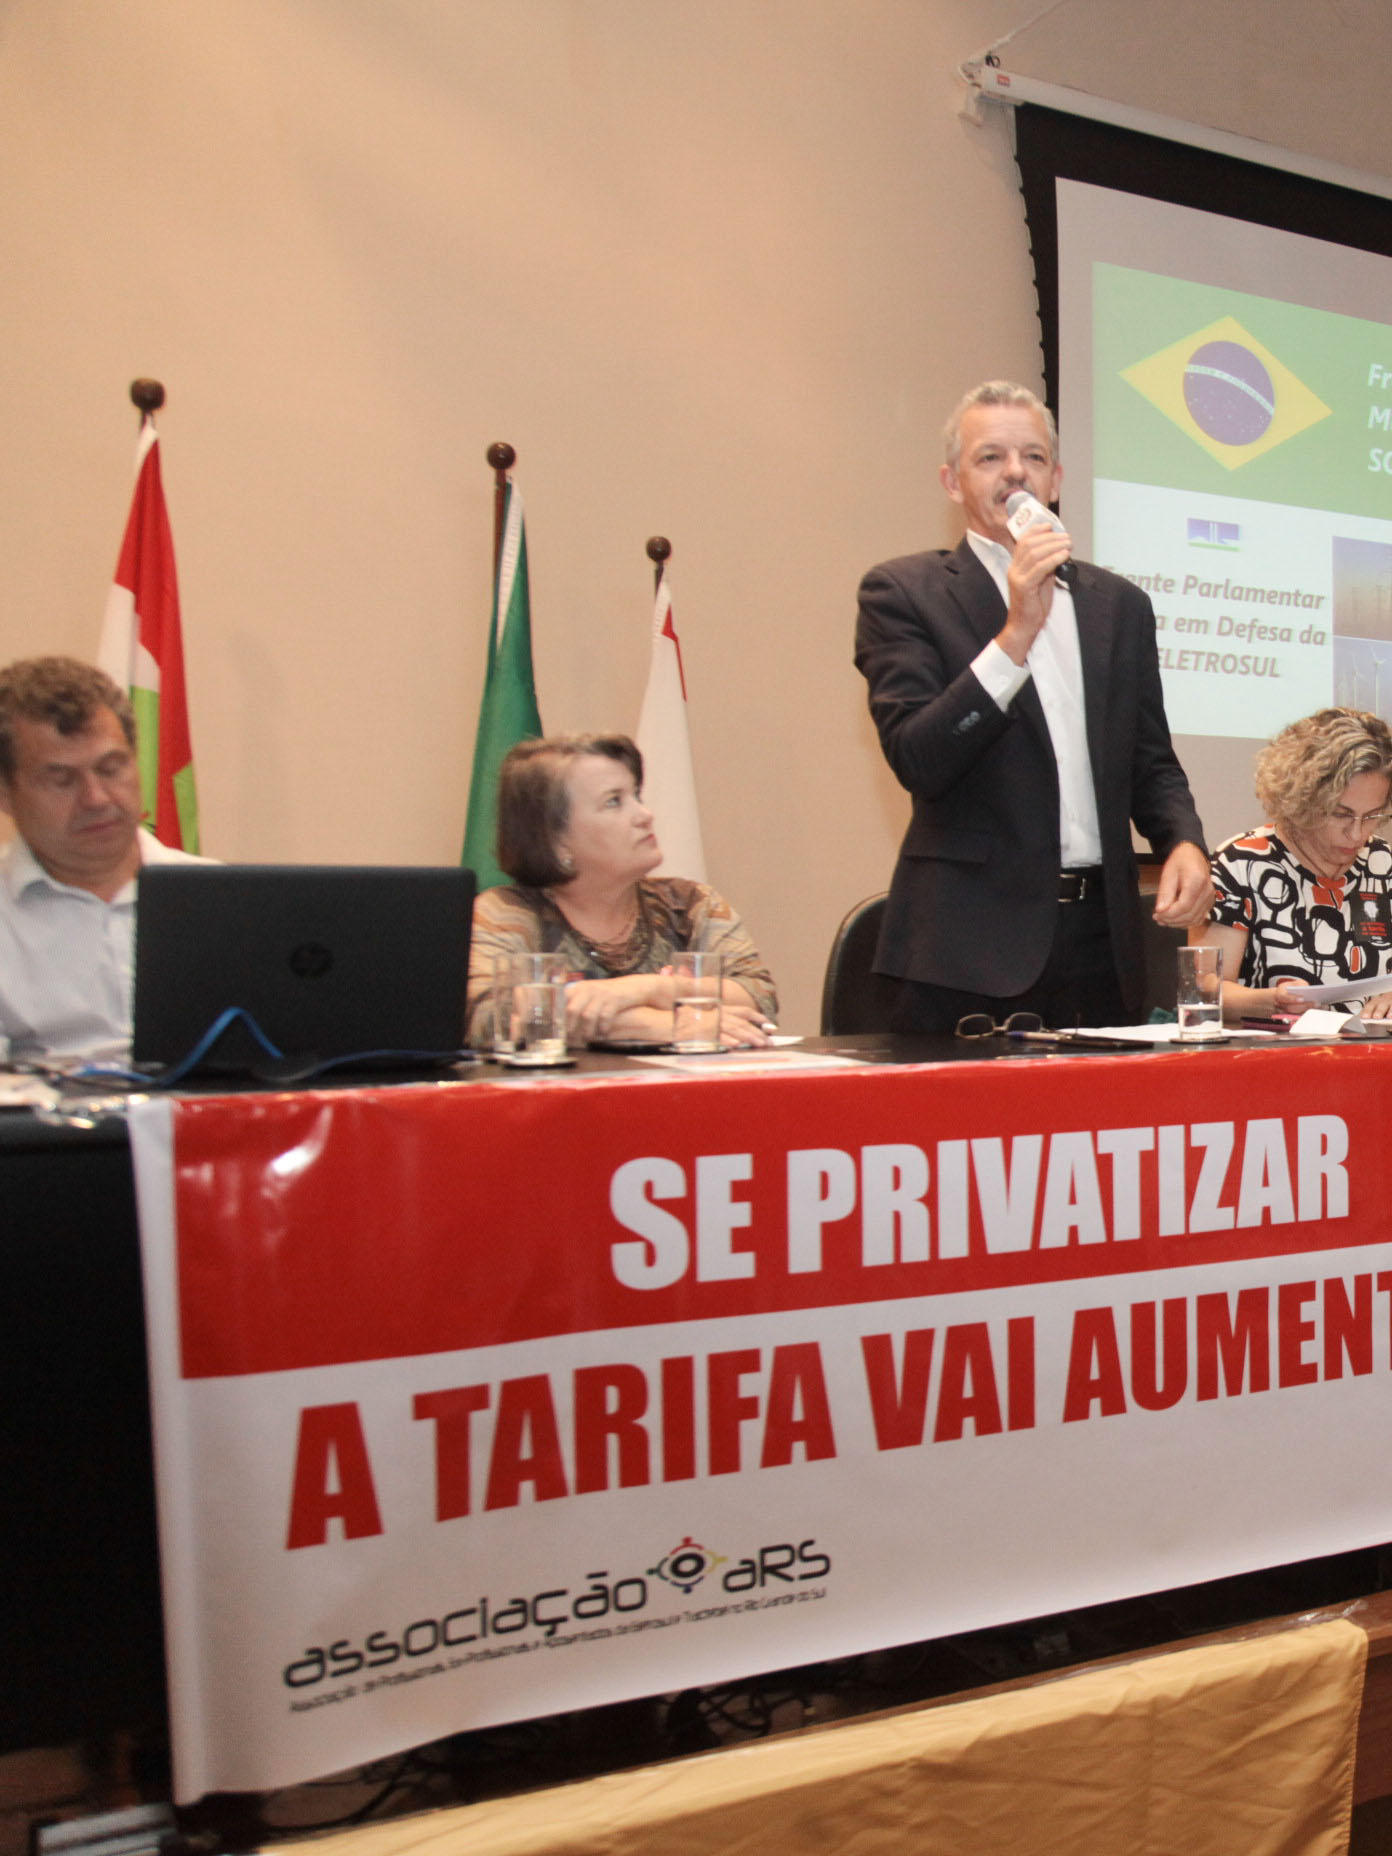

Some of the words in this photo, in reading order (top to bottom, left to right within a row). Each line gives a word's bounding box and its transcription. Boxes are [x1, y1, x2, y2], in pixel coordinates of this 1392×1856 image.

[1174, 616, 1209, 635] em
[1216, 616, 1292, 643] Defesa
[1299, 625, 1326, 646] da
[1182, 575, 1325, 609] Parlamentar
[609, 1153, 756, 1291] SE
[787, 1113, 1349, 1274] PRIVATIZAR
[286, 1401, 384, 1551] A
[412, 1341, 837, 1523] TARIFA
[860, 1315, 1035, 1451] VAI
[283, 1571, 648, 1688] associação
